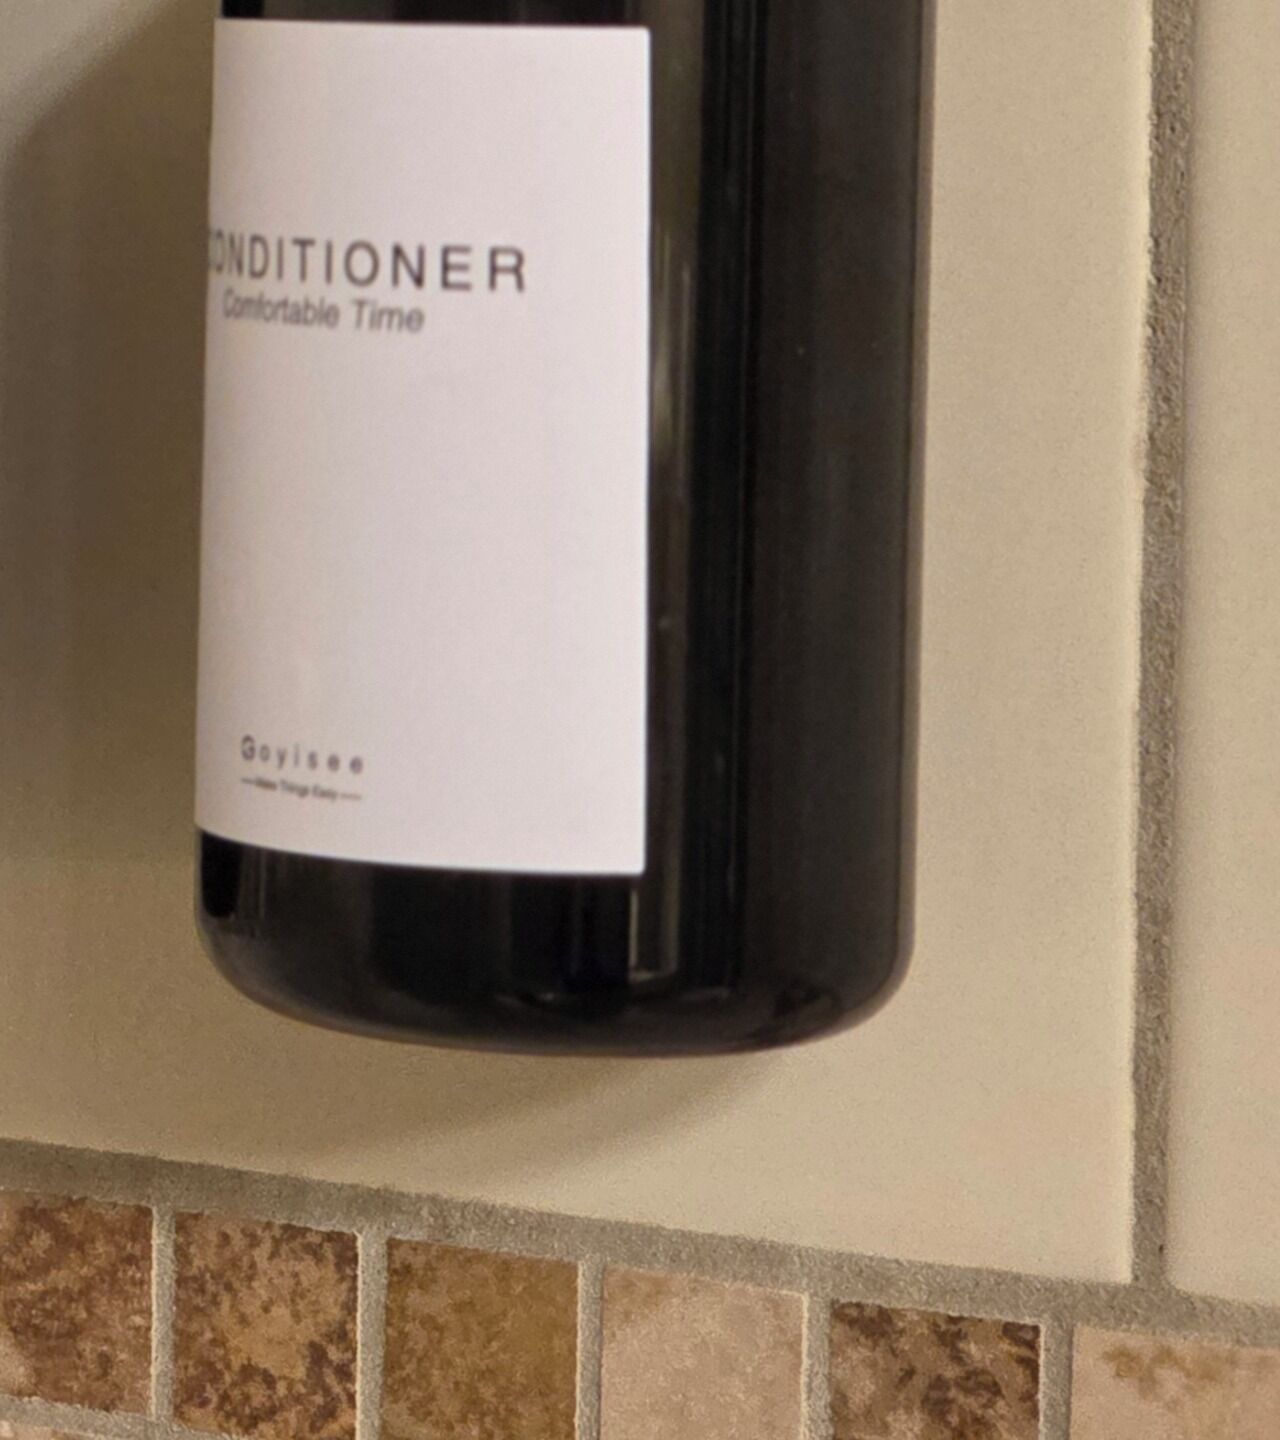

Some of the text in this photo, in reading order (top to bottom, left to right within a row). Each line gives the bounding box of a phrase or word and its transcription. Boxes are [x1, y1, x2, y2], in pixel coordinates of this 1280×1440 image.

[222, 287, 426, 334] Comfortable Time
[241, 734, 363, 774] Goyisee
